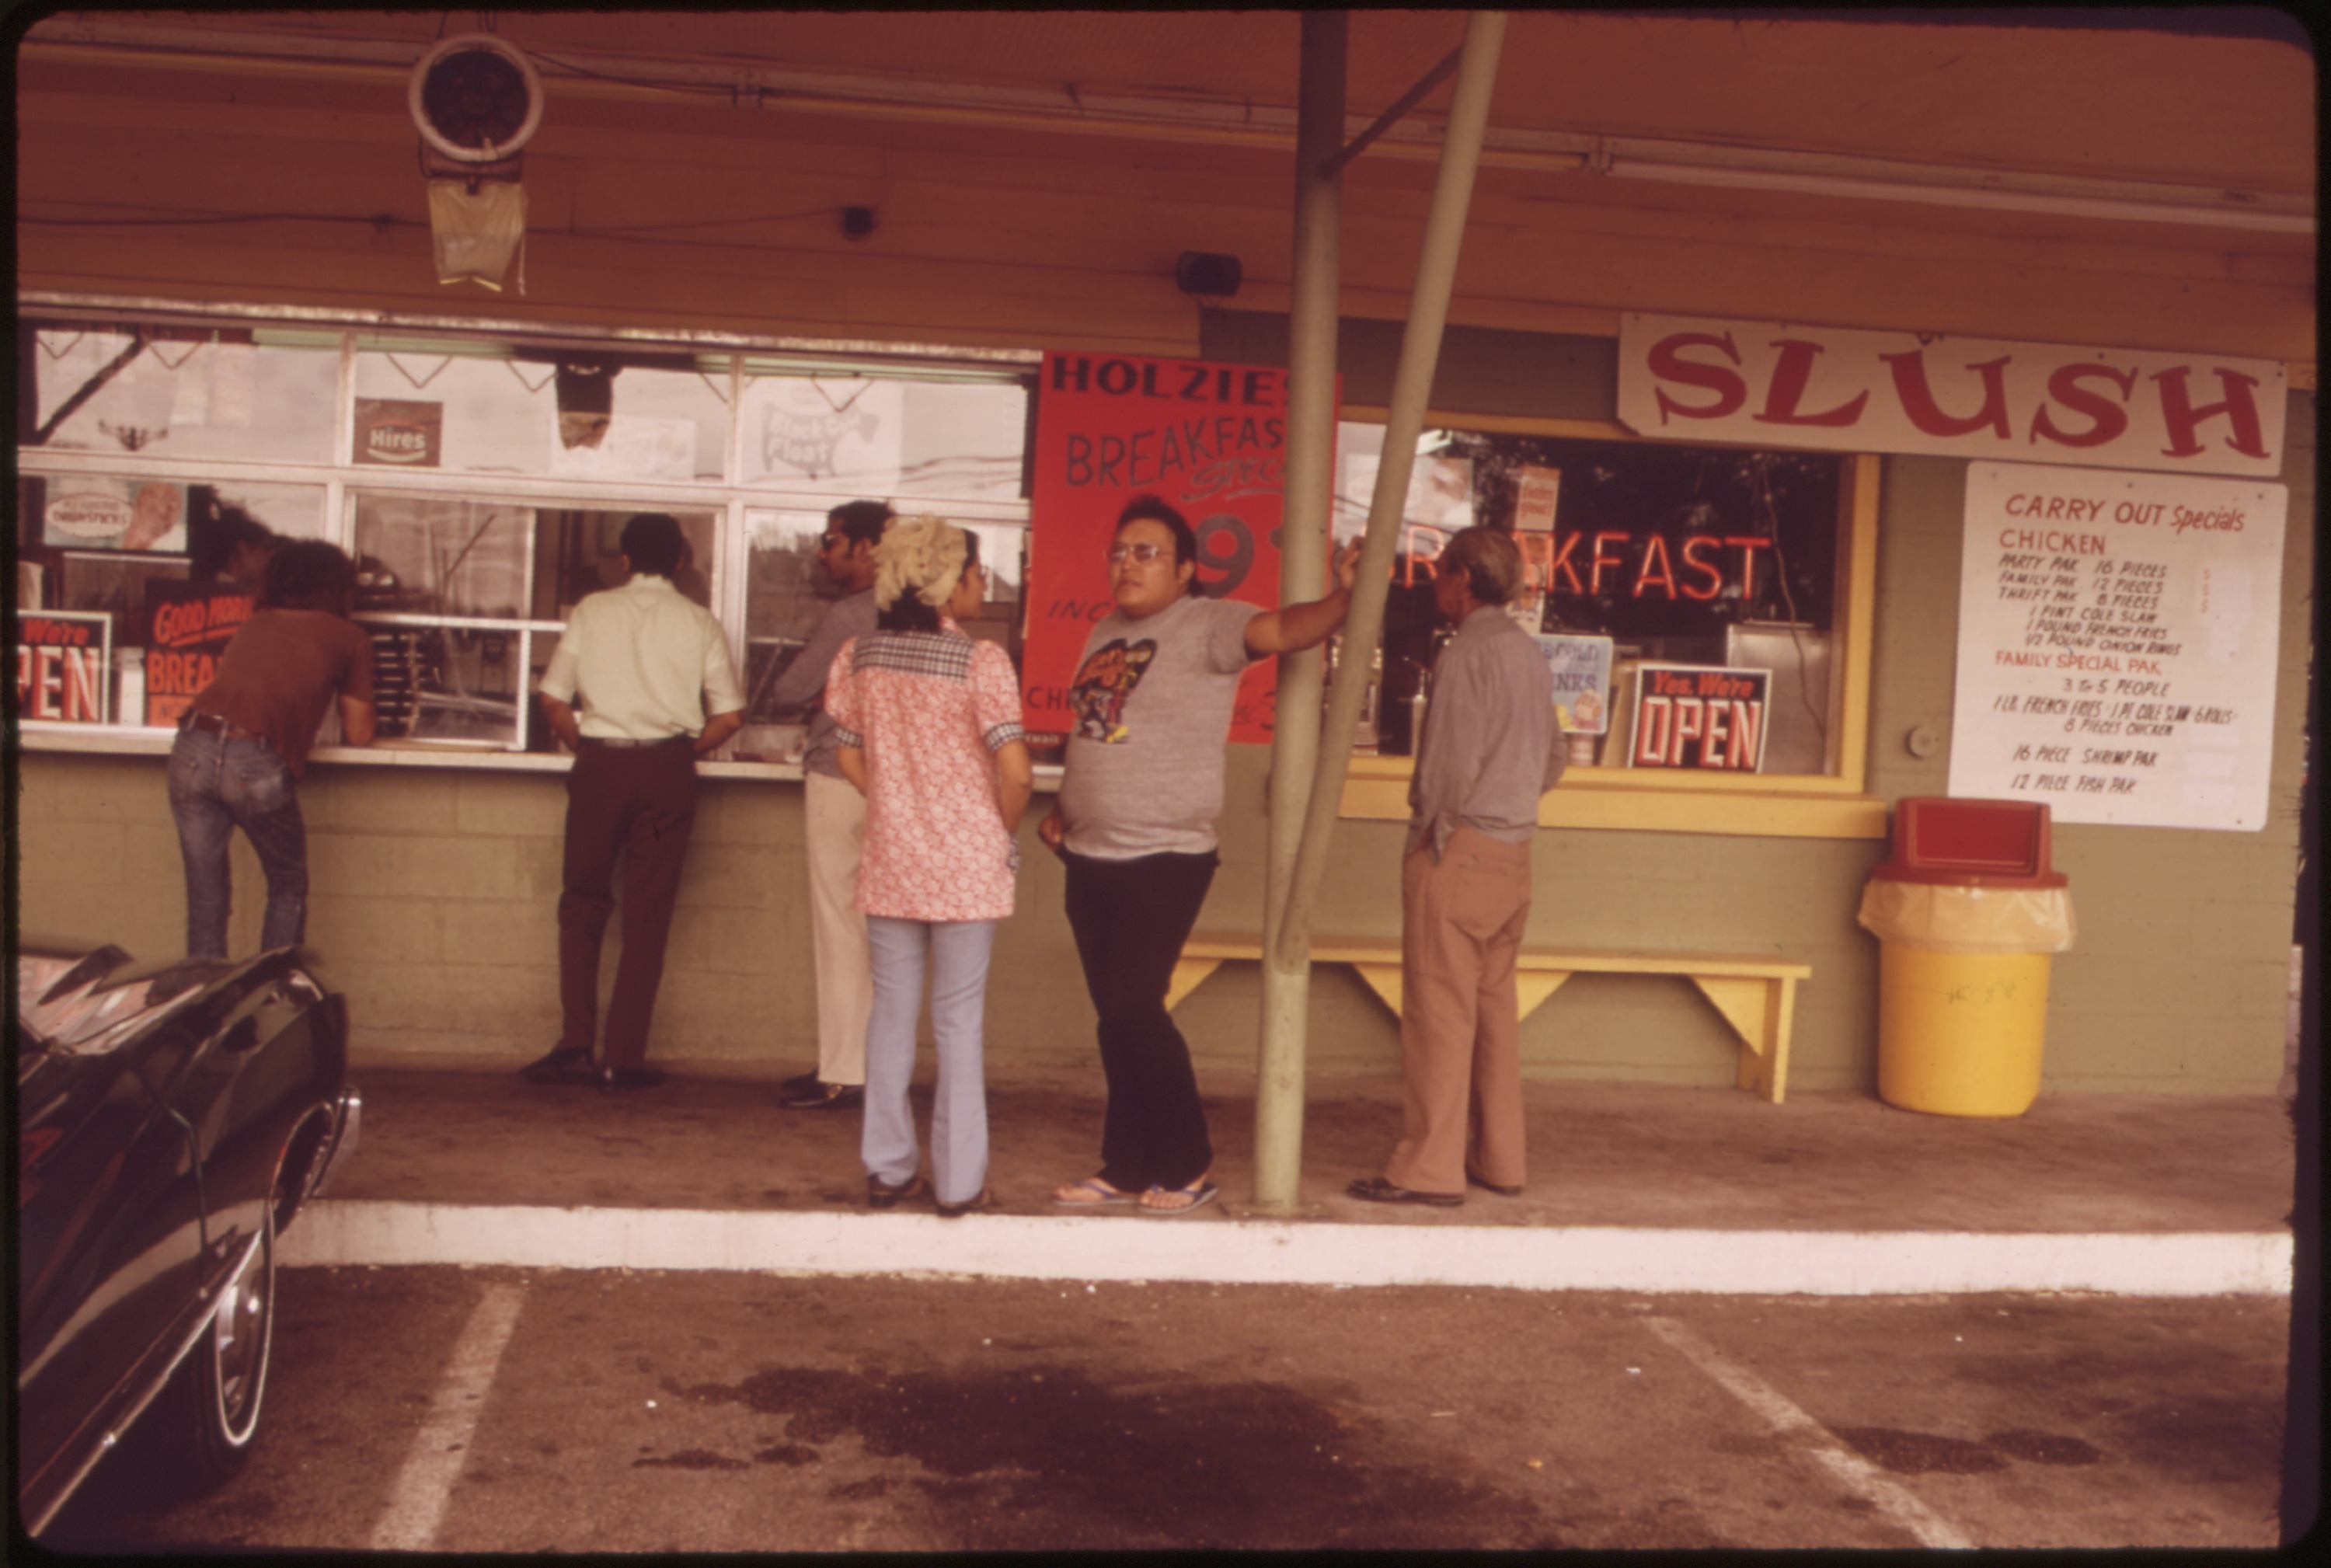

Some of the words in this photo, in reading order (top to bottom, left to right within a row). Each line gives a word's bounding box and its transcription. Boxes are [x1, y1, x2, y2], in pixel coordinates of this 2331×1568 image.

[1647, 331, 2270, 458] SLUSH
[370, 425, 426, 449] Hires
[768, 438, 830, 463] Float
[1066, 416, 1283, 487] BREAKFAS
[2005, 493, 2106, 522] CARRY
[2114, 501, 2166, 525] OUT
[2169, 505, 2245, 535] Specials
[1999, 528, 2106, 556] CHICKEN
[1363, 524, 1772, 601] RAKFAST
[1998, 553, 2047, 570] PARTY
[2050, 556, 2080, 573] PAK
[2095, 559, 2113, 575] 16
[2120, 561, 2168, 579] PIECES
[1998, 570, 2051, 586] FAMILY
[2053, 574, 2078, 587] PAK
[2092, 577, 2110, 591] 12
[2114, 578, 2163, 595] PIECES
[1048, 599, 1110, 623] INC
[1998, 586, 2051, 601] THRIFT
[2053, 591, 2078, 603] PAK
[2112, 594, 2159, 611] PIECES
[154, 601, 206, 644] GOOD
[2040, 605, 2075, 619] PINT
[2080, 607, 2114, 621] COLE
[2120, 609, 2158, 624] SLAW
[2035, 618, 2082, 634] POUND
[2134, 625, 2169, 640] FRIES
[2046, 632, 2095, 648] POUND
[2099, 639, 2144, 653] ONION
[148, 651, 224, 694] BREA
[1995, 650, 2053, 667] FAMILY
[2056, 653, 2122, 673] SPECIAL
[2128, 658, 2162, 676] PAK
[17, 645, 101, 722] PEN
[1552, 673, 1598, 692] NKS
[2063, 678, 2074, 693] 3
[2097, 679, 2109, 694] 5
[2114, 679, 2172, 697] PEOPLE
[1026, 685, 1071, 710] CHI
[1636, 695, 1762, 768] OPEN
[2078, 718, 2120, 735] PIECES
[2012, 744, 2031, 761] 16
[2035, 745, 2071, 763] PIECE
[2081, 747, 2133, 765] SHRIMP
[2131, 750, 2159, 767] PAK
[2011, 773, 2030, 790] 12
[2034, 774, 2070, 791] PIECE
[2075, 775, 2106, 793] FISH
[2107, 777, 2137, 794] PAK
